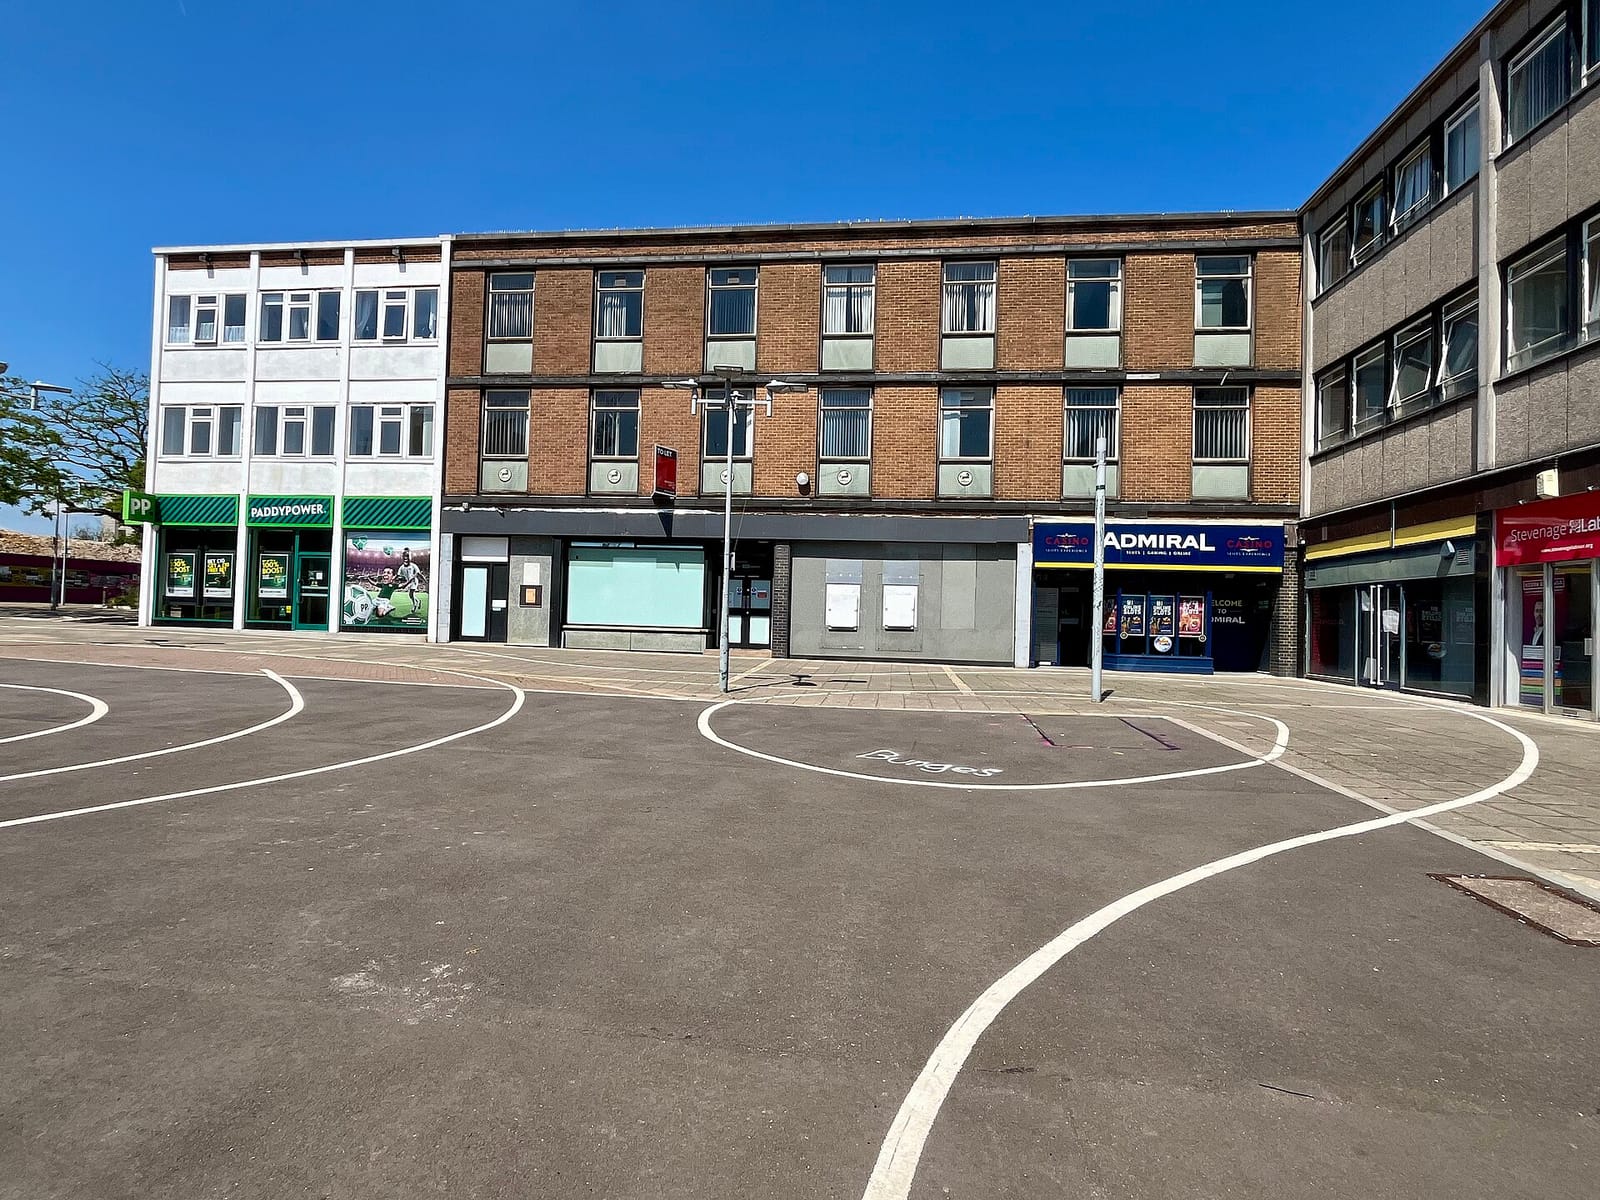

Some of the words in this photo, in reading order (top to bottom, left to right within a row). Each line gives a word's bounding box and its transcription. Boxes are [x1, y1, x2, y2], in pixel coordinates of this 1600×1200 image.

[130, 498, 151, 516] PP
[1510, 525, 1567, 542] Stevenage
[1045, 537, 1089, 545] CASINO
[1103, 532, 1216, 551] ADMIRAL
[1226, 540, 1272, 548] CASINO
[1211, 599, 1243, 607] ELCOME
[1211, 616, 1246, 624] MIRAL
